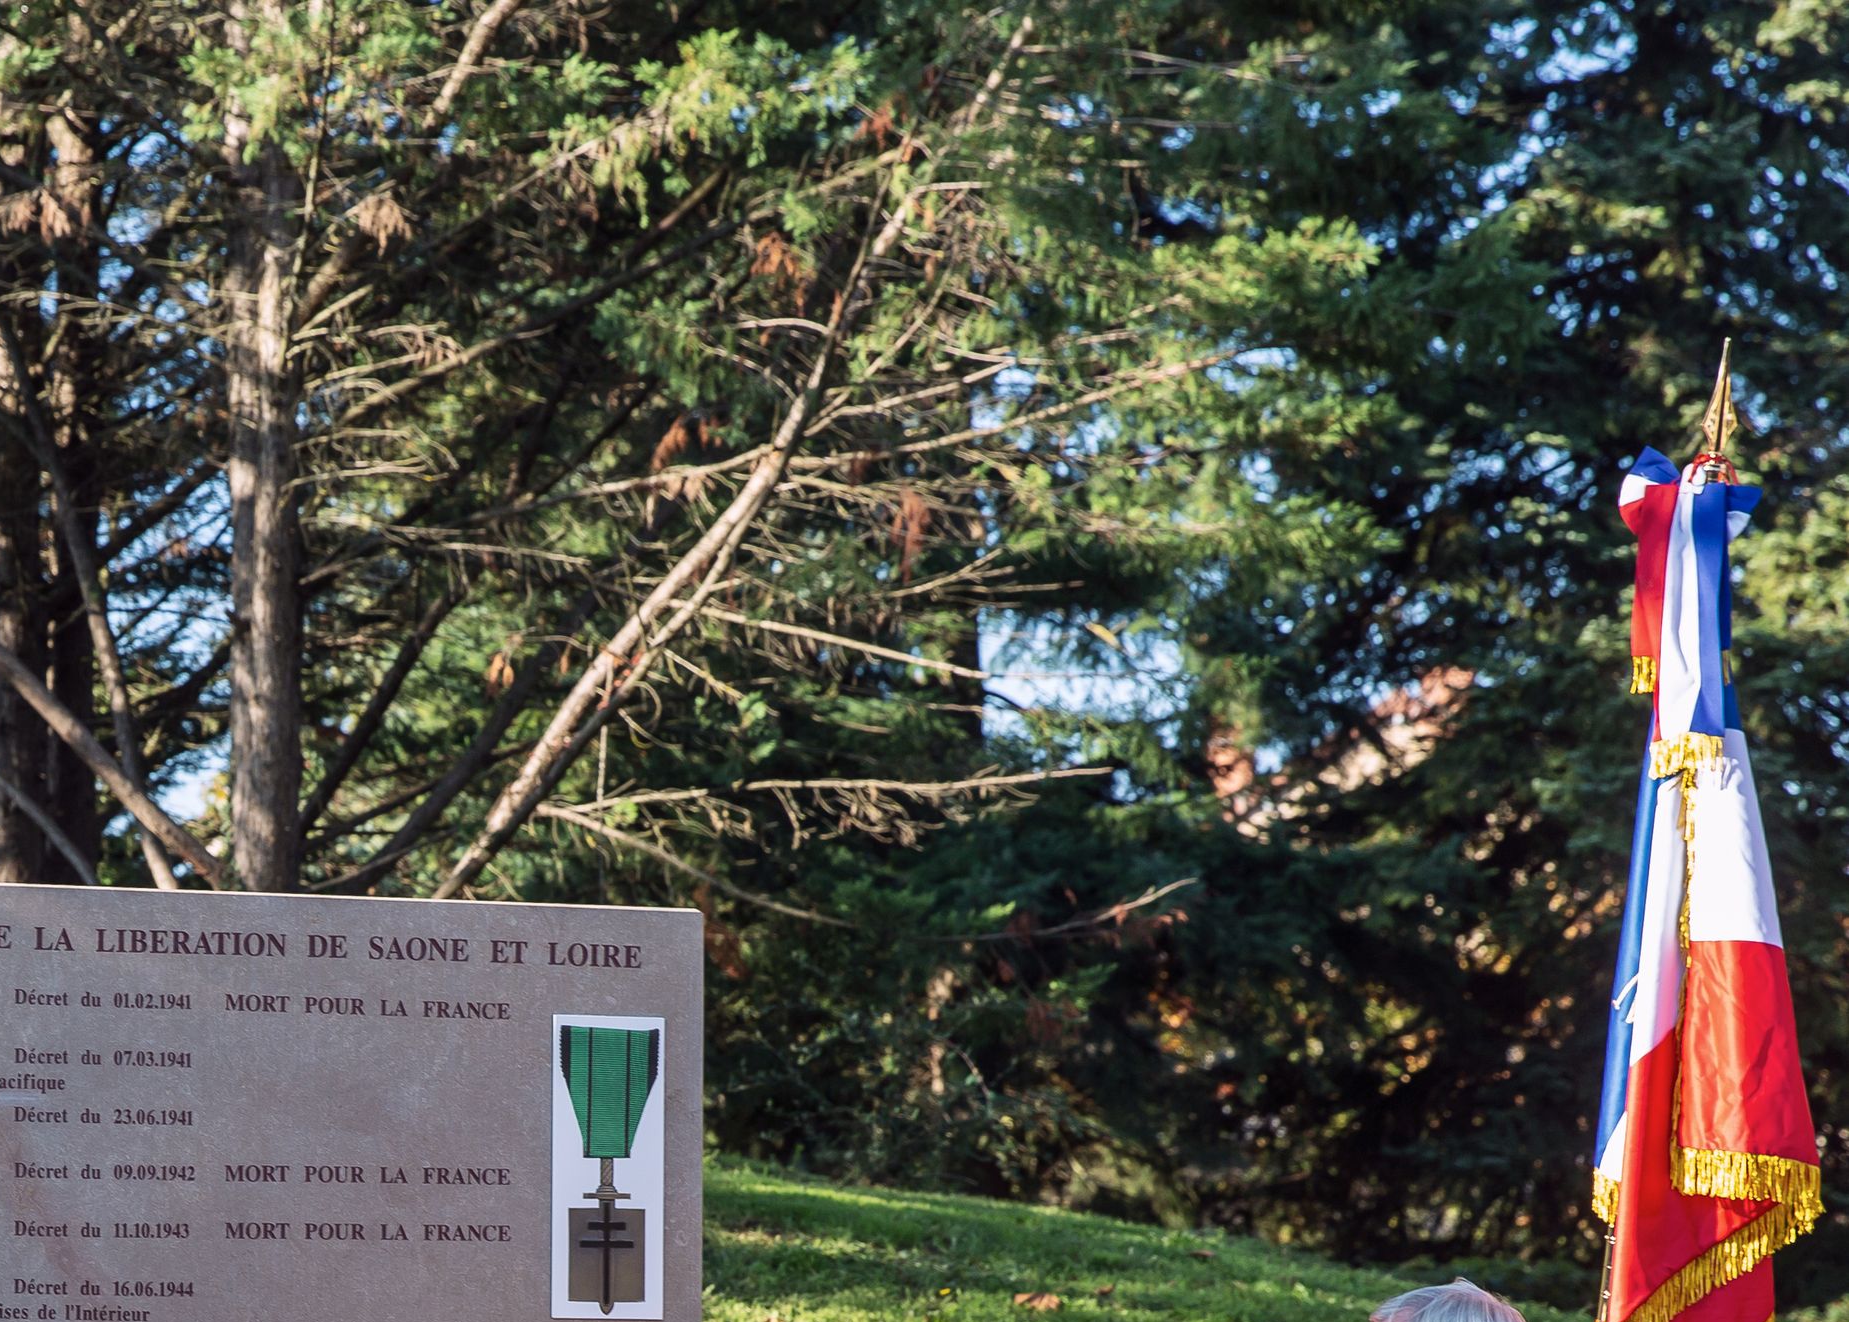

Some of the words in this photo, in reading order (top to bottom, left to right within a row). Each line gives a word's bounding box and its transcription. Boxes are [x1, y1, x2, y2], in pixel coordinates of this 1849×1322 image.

[34, 927, 75, 951] LA
[96, 929, 286, 957] LIBERATION
[307, 935, 348, 958] DE
[369, 936, 469, 962] SAONE
[490, 940, 528, 964] ET
[548, 942, 642, 968] LOIRE
[15, 989, 68, 1006] Décret
[81, 991, 101, 1007] du
[114, 993, 191, 1009] 01.02.1941
[225, 994, 290, 1013] MORT
[304, 997, 365, 1015] POUR
[381, 999, 408, 1016] LA
[423, 1001, 511, 1020] FRANCE
